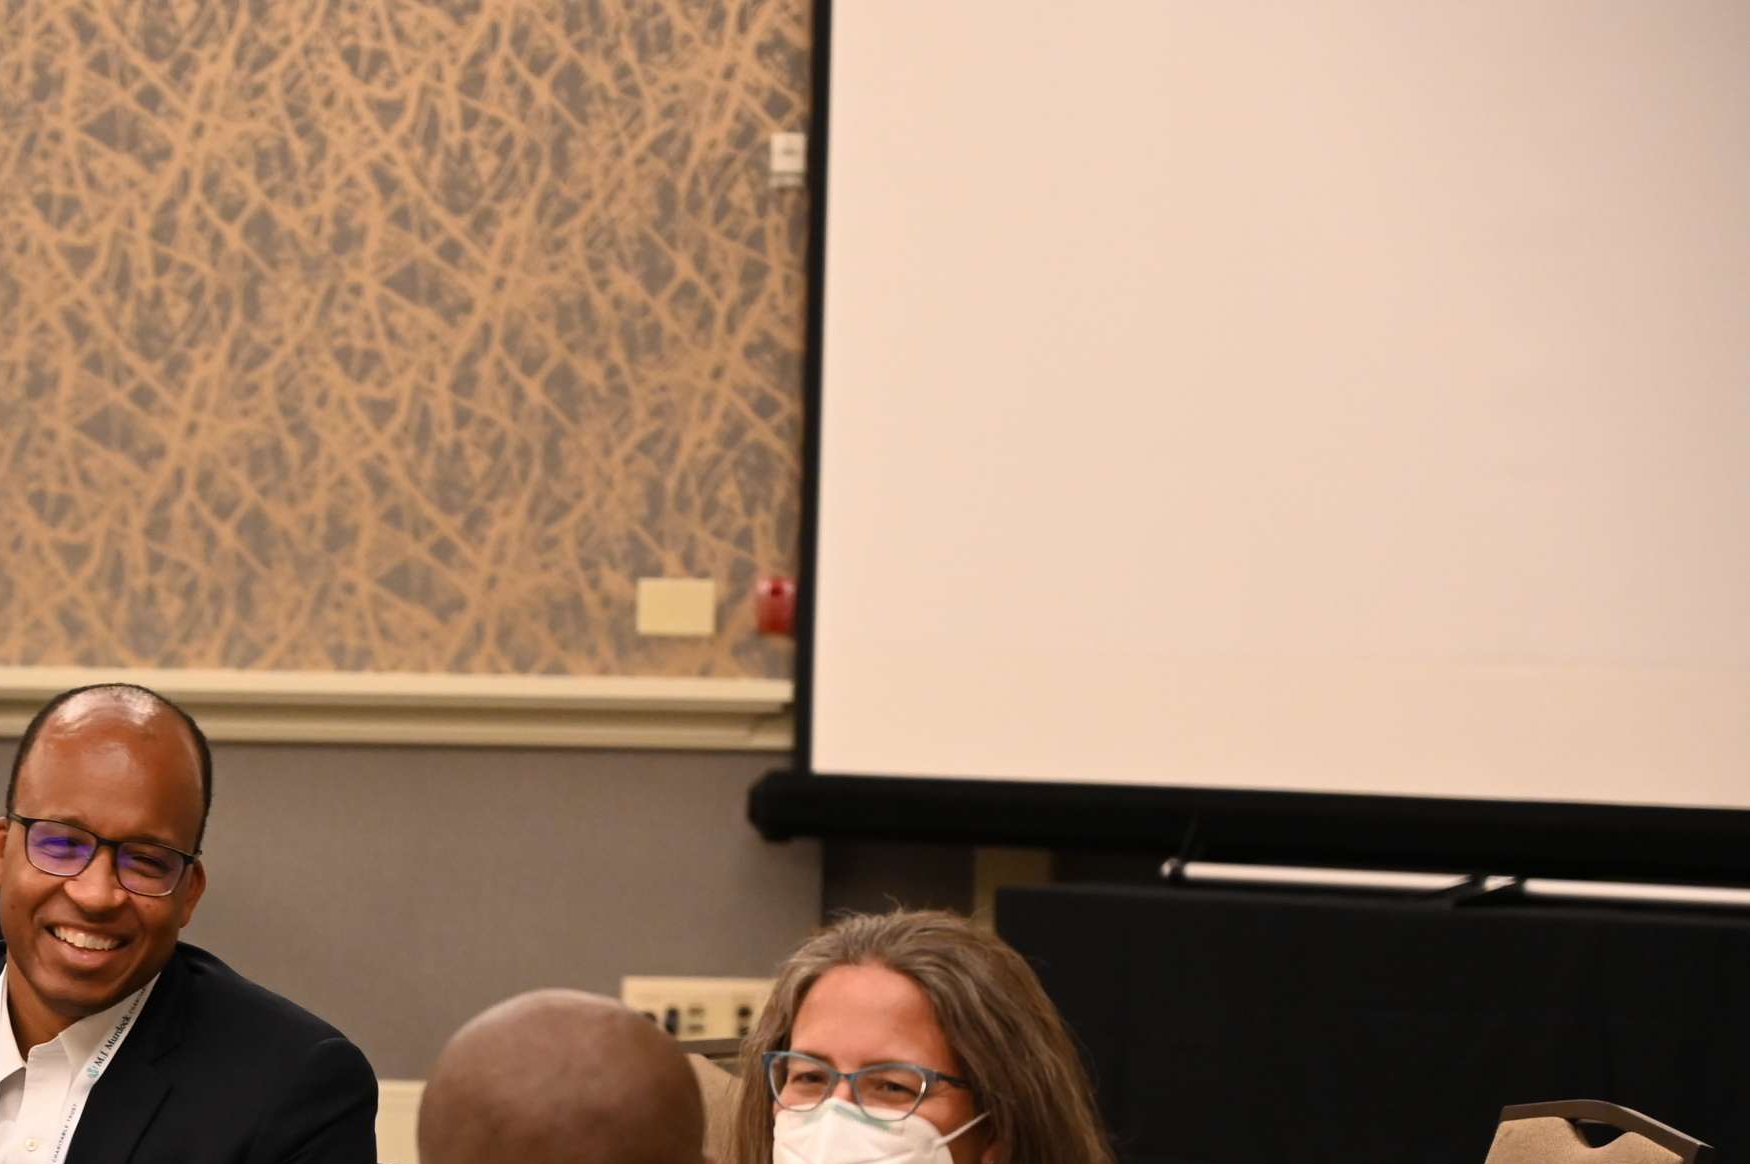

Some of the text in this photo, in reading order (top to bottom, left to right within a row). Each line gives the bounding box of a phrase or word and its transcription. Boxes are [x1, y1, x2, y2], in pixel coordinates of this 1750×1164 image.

[105, 1015, 131, 1050] Murdock
[52, 1125, 69, 1163] CHARITABLE
[66, 1103, 78, 1122] TRUST
